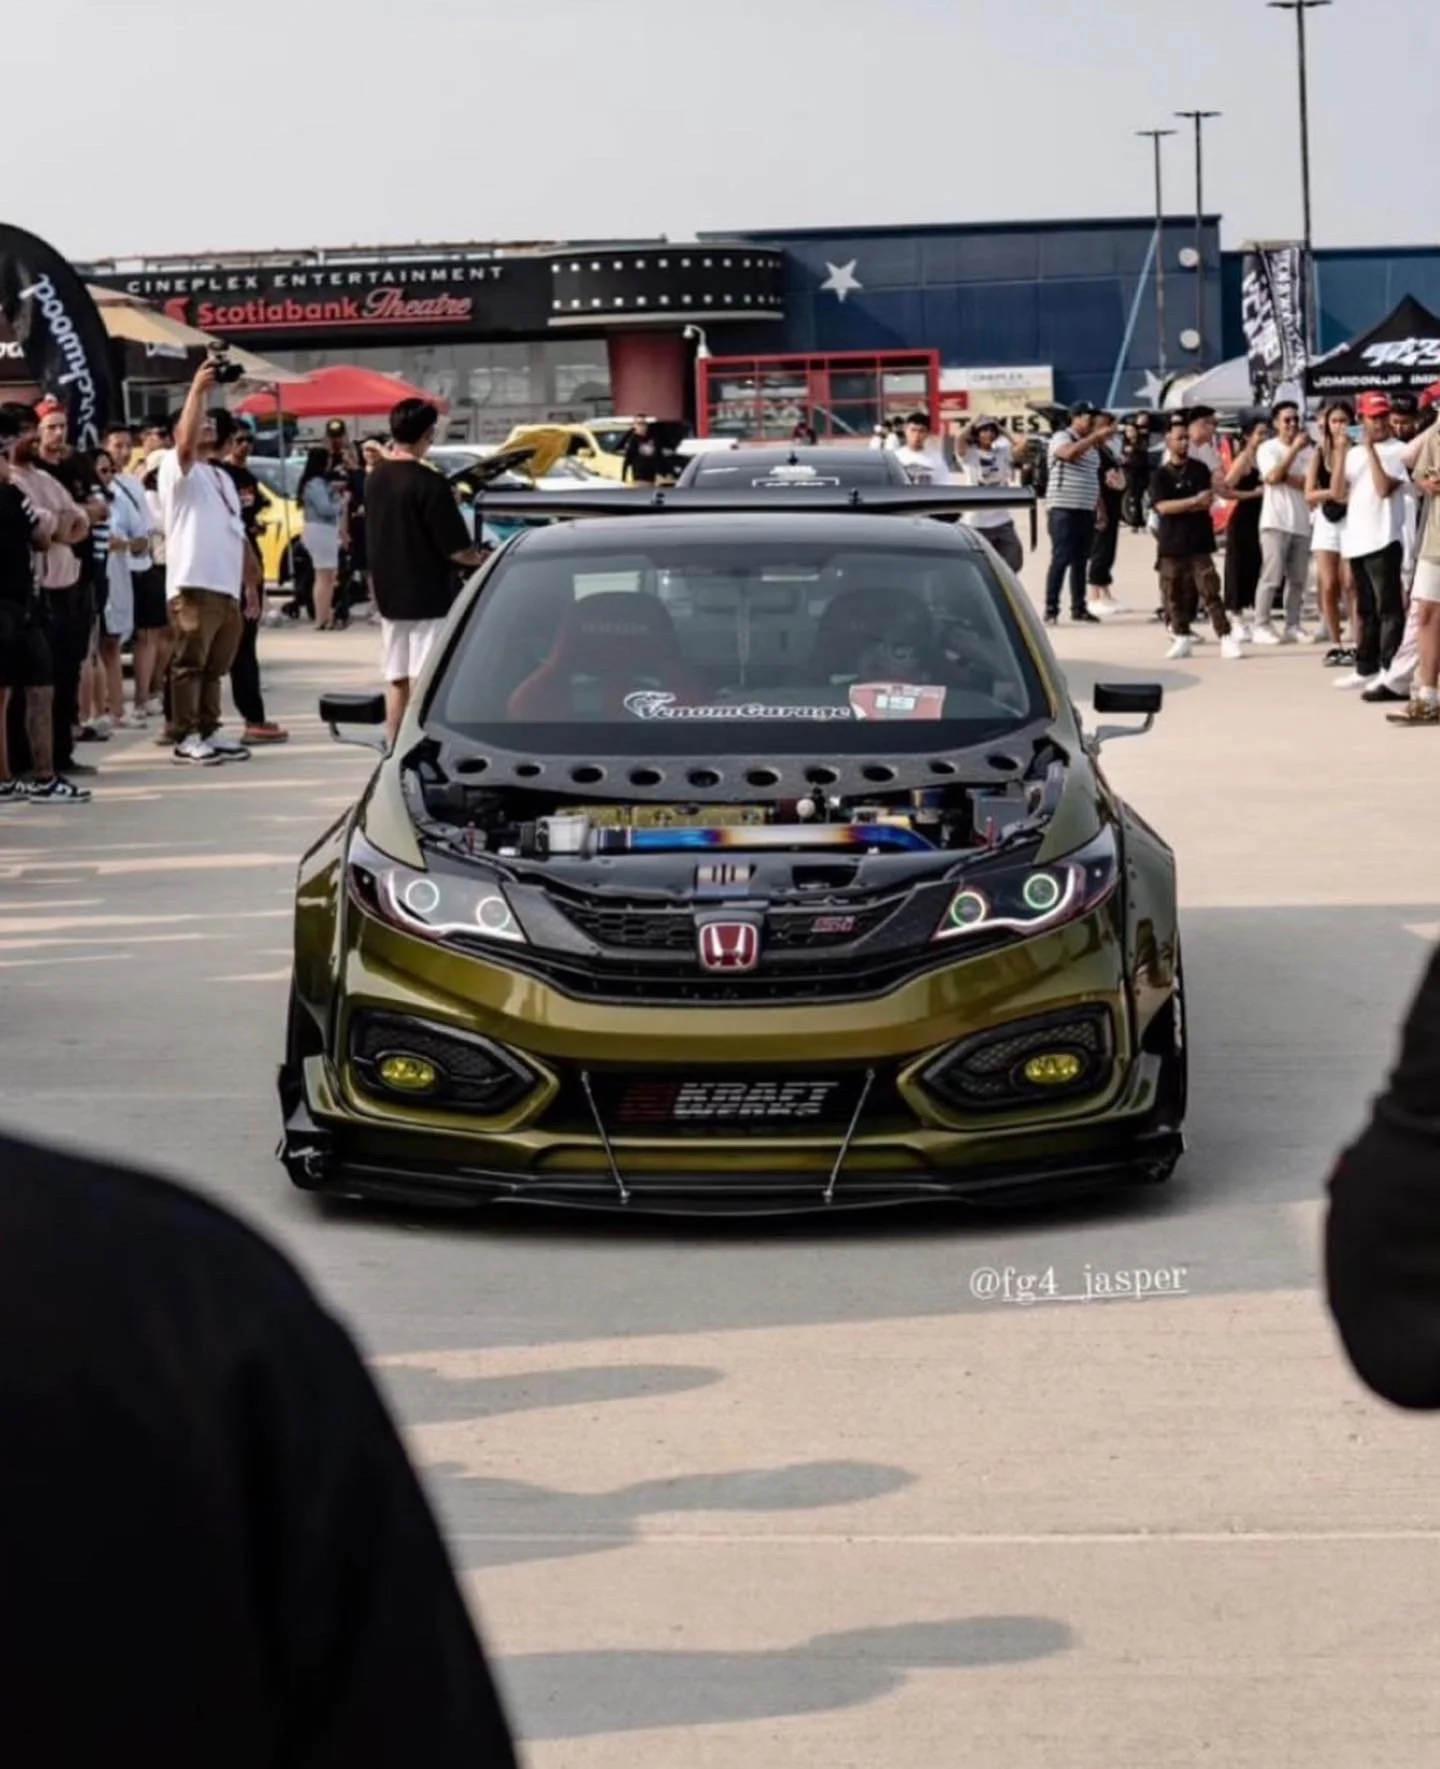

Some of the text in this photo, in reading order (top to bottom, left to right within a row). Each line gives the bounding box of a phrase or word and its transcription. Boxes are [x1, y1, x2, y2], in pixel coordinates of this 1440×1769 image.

[127, 266, 503, 294] CINEPLEX ENTERTAINMENT
[199, 286, 473, 325] Scotiabank Theatre
[633, 692, 851, 720] VenomGarage
